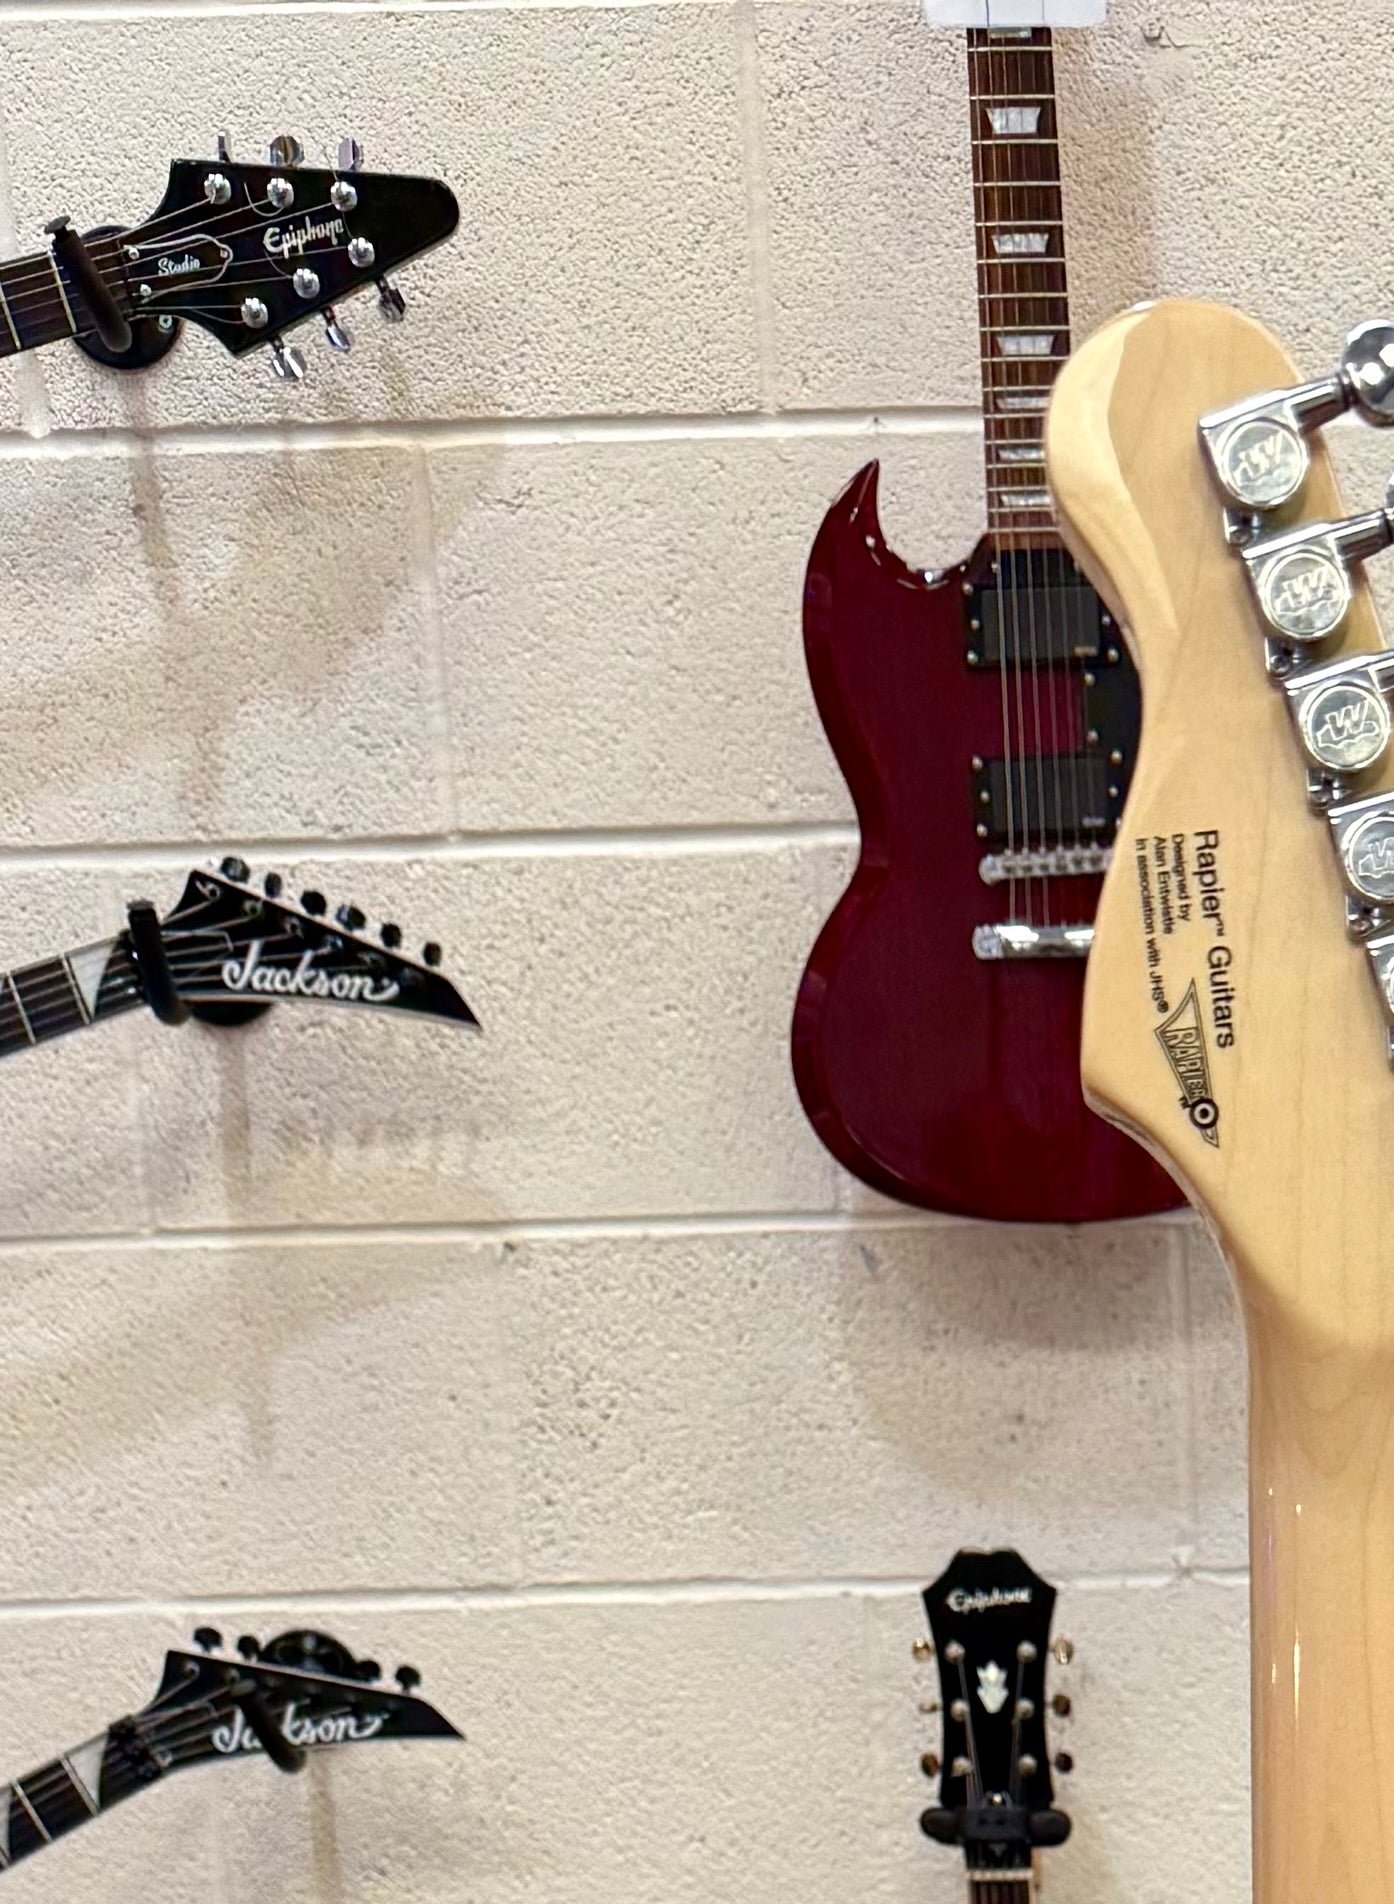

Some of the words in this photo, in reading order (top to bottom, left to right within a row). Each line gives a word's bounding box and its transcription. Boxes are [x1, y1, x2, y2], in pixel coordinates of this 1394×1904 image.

[158, 254, 201, 277] Studio
[263, 216, 345, 259] Epiphone
[1154, 836, 1167, 867] Alan
[1171, 833, 1191, 900] Designed
[1137, 855, 1155, 934] association
[1146, 937, 1161, 968] with
[1157, 871, 1175, 934] Entwistle
[1177, 903, 1192, 922] by
[222, 940, 399, 1000] Jackson
[1207, 945, 1235, 1049] Guitars
[1163, 1026, 1207, 1100] RAPIER
[212, 1702, 390, 1753] Jakson
